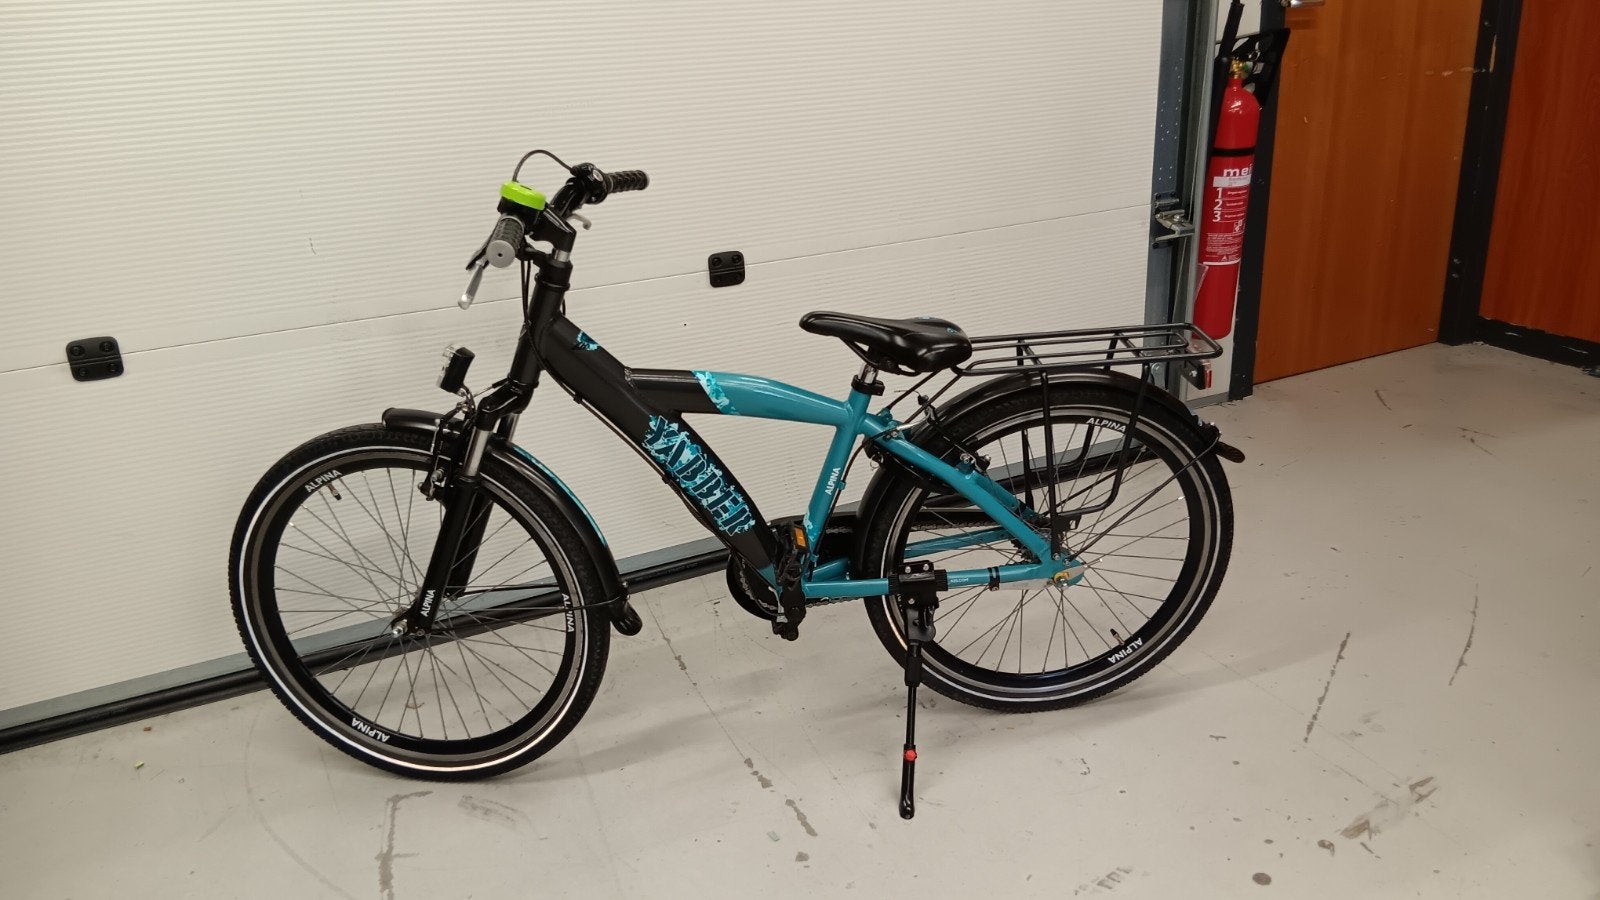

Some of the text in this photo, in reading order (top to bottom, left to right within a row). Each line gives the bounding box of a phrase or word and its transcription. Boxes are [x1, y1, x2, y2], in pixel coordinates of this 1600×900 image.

[1213, 198, 1223, 211] 2
[1216, 187, 1223, 199] 1
[1212, 210, 1221, 222] 3
[1086, 417, 1126, 432] ALPINA
[304, 469, 342, 493] ALPINA
[824, 467, 841, 495] ALPINA
[420, 589, 436, 617] ALPINA
[1107, 637, 1143, 663] ALPINA
[351, 717, 390, 742] ALPINA
